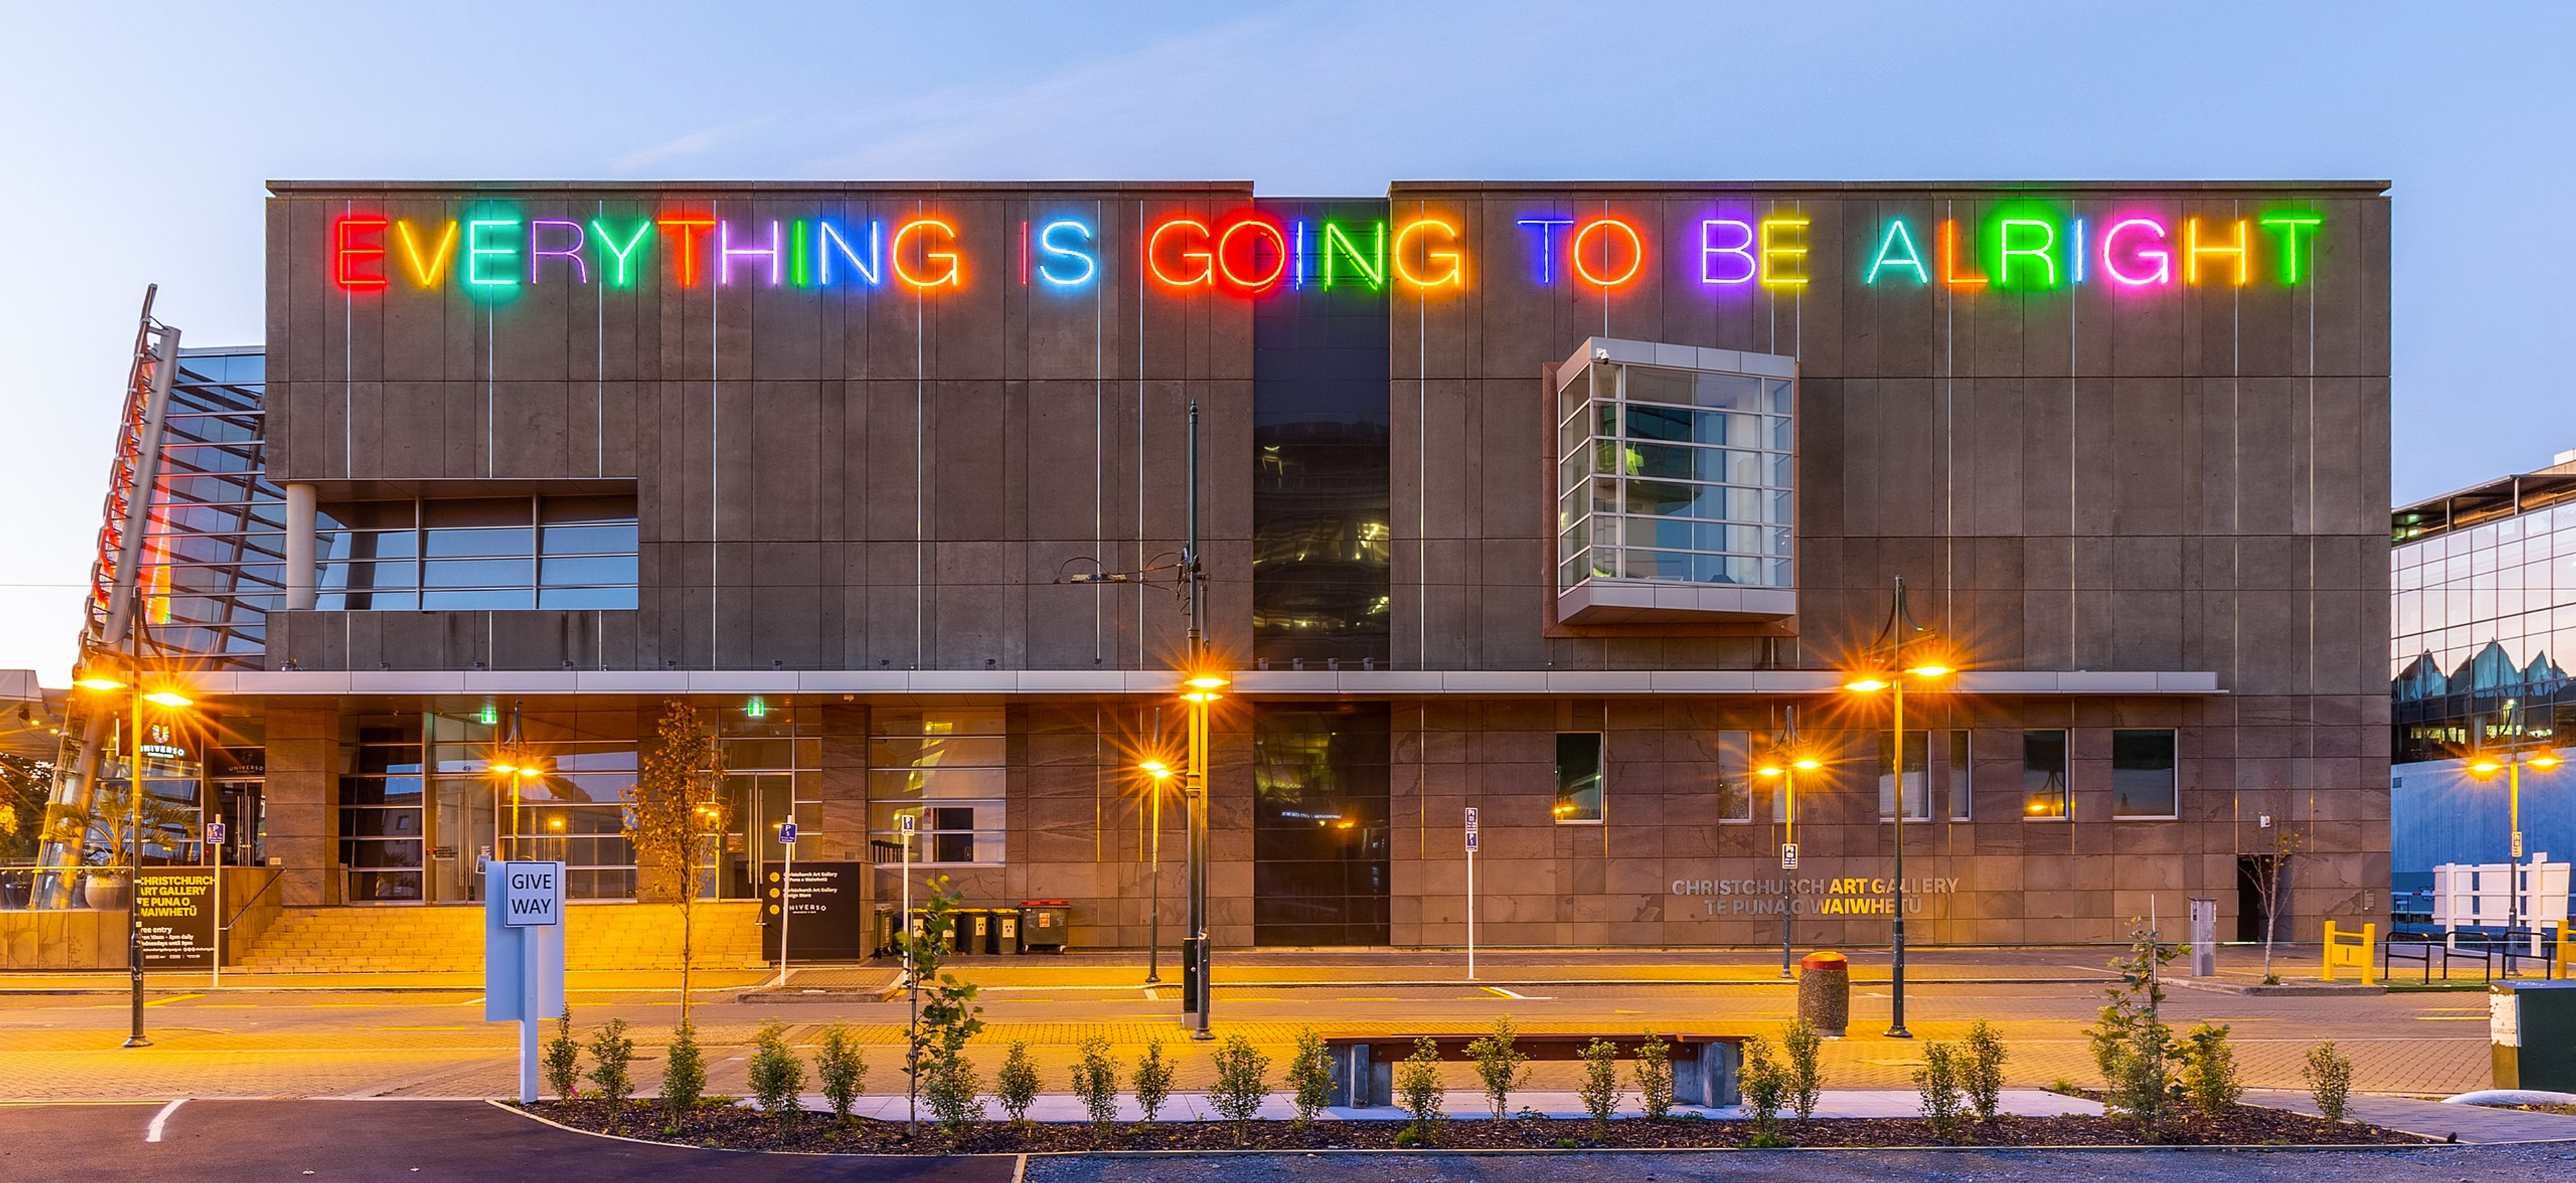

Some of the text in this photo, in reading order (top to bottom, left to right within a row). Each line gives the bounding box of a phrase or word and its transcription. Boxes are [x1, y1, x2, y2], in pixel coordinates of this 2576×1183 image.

[339, 219, 2322, 287] EVERYTHING IS GOING TO BE ALRIGHT
[512, 874, 551, 889] GIVE
[1671, 878, 1960, 896] CHRISTCHURCH ART GALLERY
[159, 887, 206, 895] GALLERY
[151, 897, 180, 906] PUNA
[181, 897, 191, 906] O
[511, 899, 551, 914] WAY
[1705, 899, 1728, 915] TE
[1733, 899, 1787, 915] PUNA
[1790, 899, 1805, 915] O
